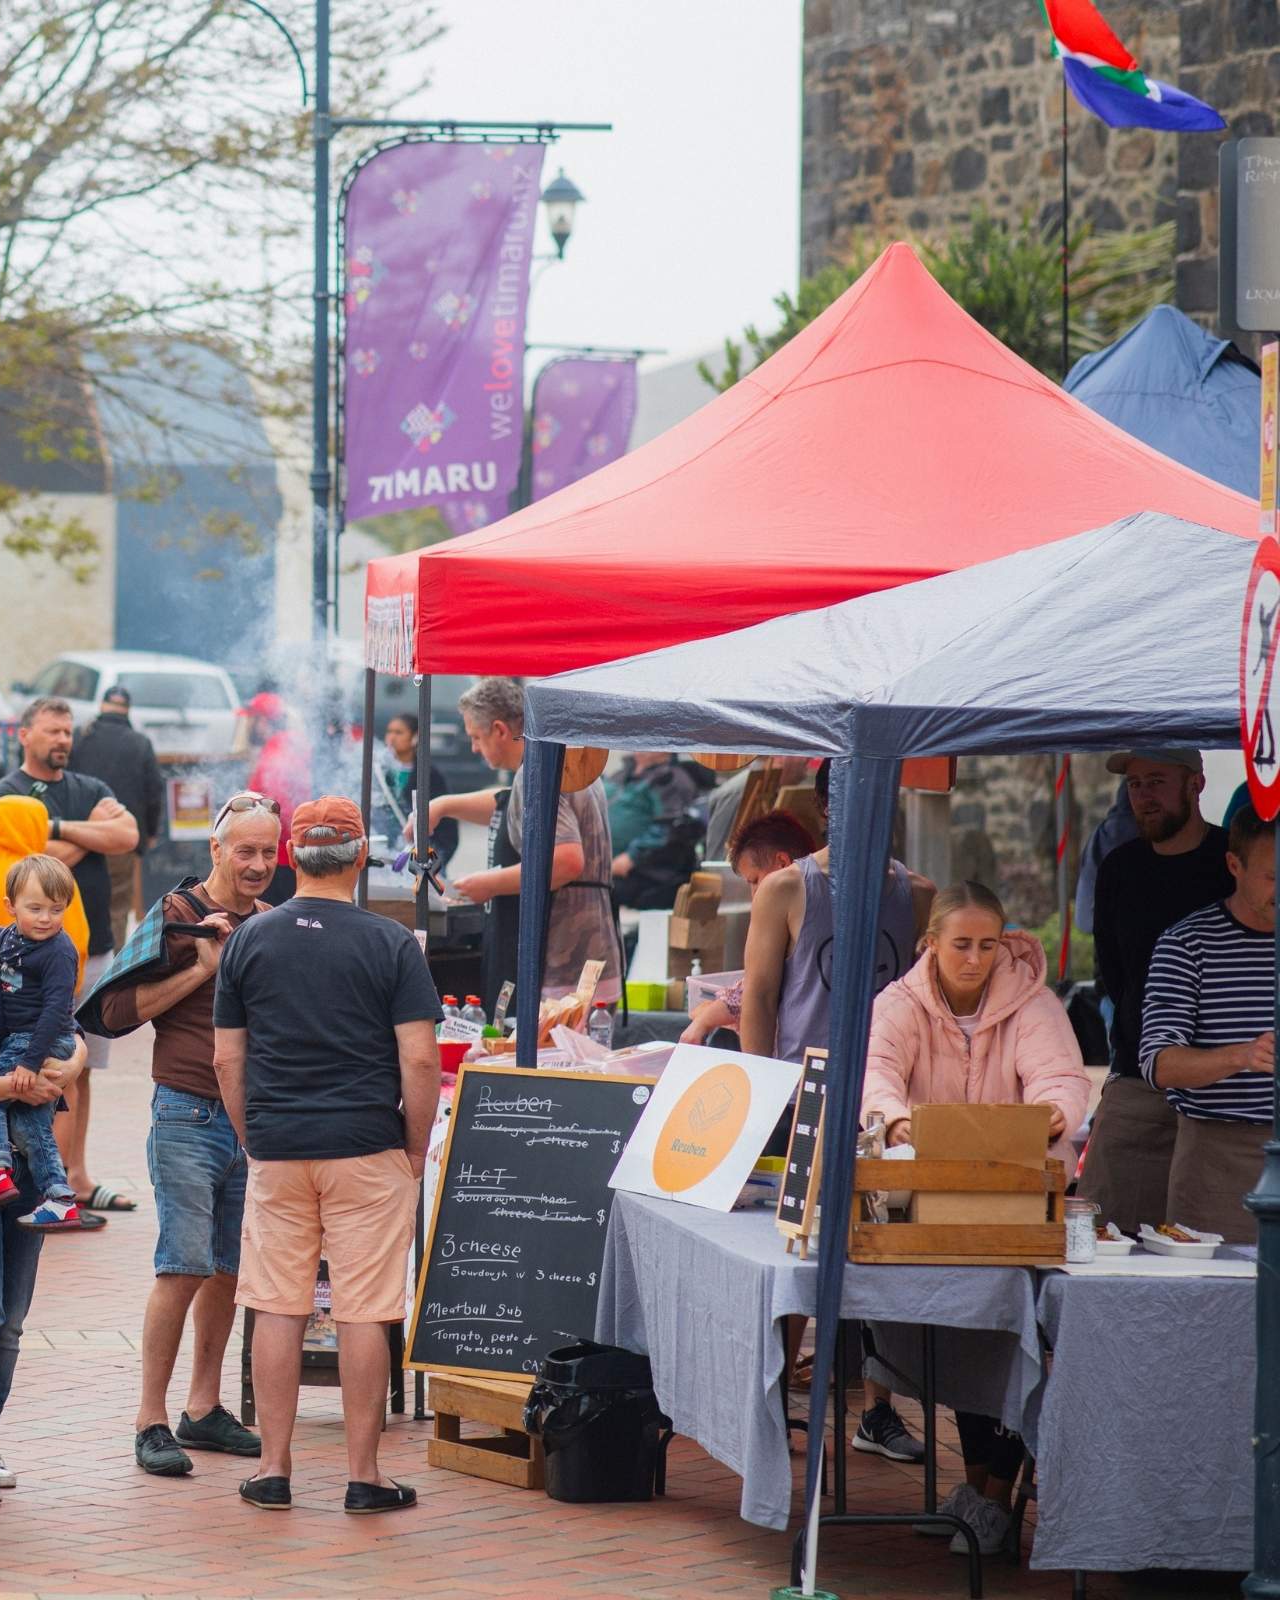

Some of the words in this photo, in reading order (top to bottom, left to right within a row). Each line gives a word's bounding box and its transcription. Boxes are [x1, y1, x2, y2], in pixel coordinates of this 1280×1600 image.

[367, 460, 498, 504] TIMARU
[476, 1085, 553, 1113] Reuben
[441, 1233, 456, 1258] 3
[459, 1239, 522, 1258] cheese
[450, 1265, 508, 1282] Sourdough
[515, 1271, 526, 1279] w
[535, 1269, 545, 1281] 3
[548, 1271, 582, 1283] cheese
[425, 1301, 487, 1318] Meatball
[495, 1303, 523, 1318] Sub
[490, 1332, 519, 1345] pesto
